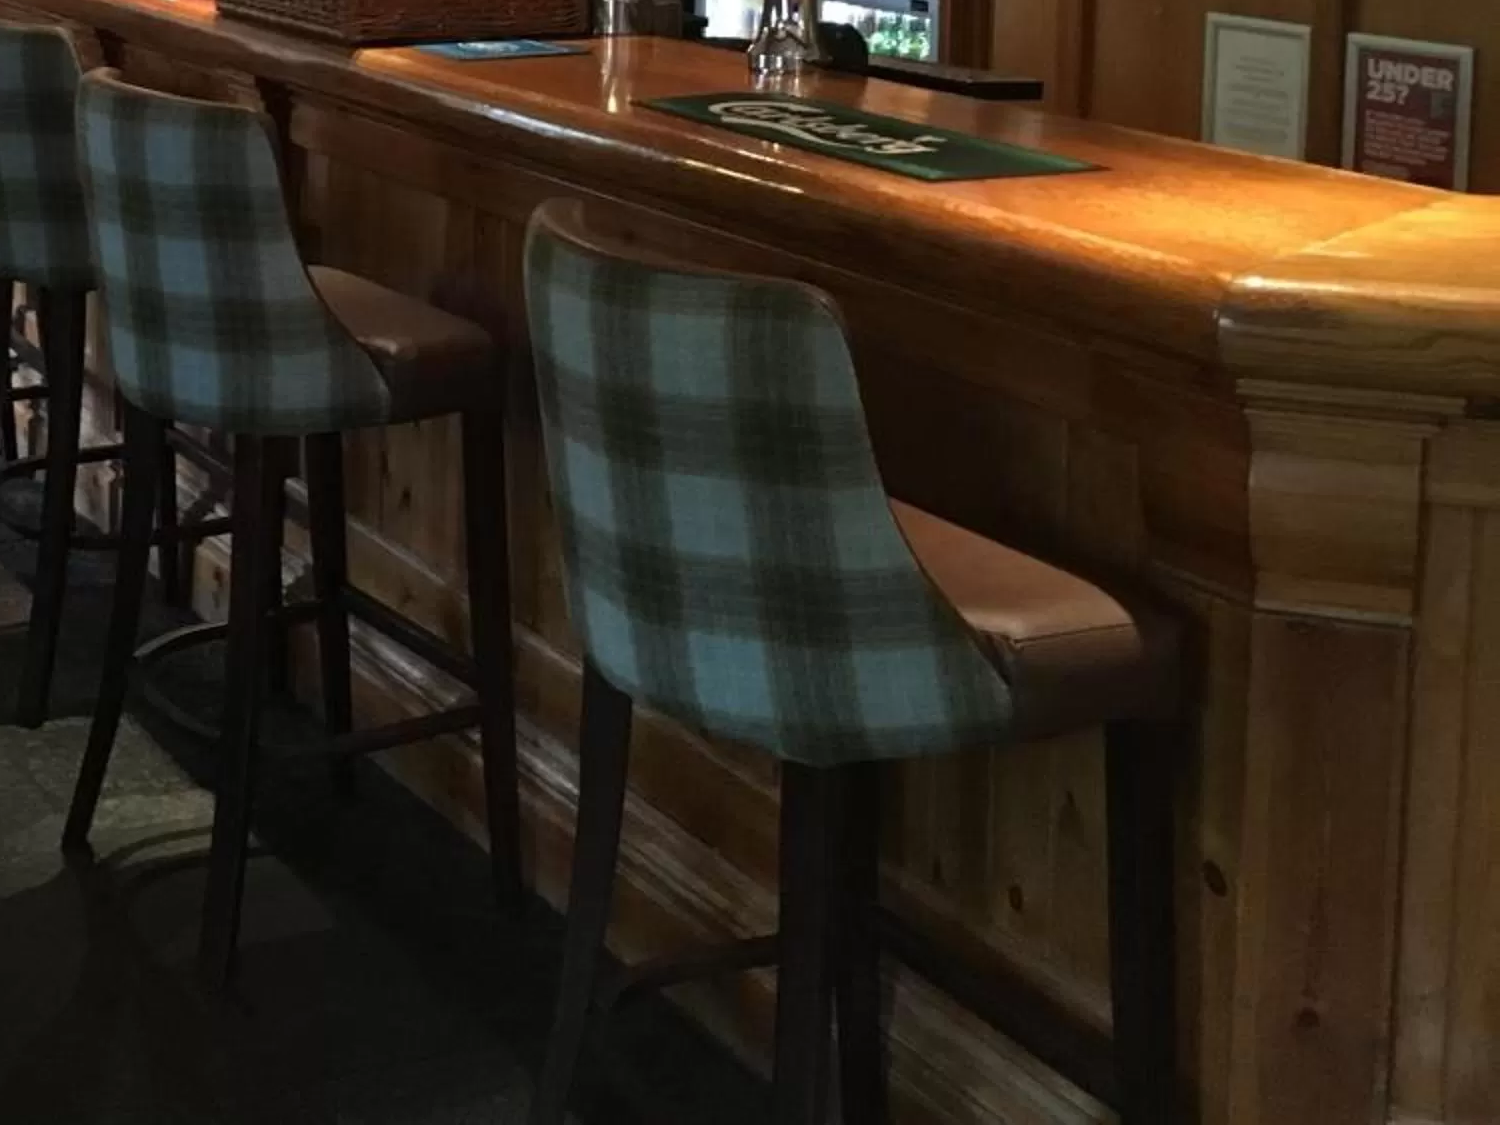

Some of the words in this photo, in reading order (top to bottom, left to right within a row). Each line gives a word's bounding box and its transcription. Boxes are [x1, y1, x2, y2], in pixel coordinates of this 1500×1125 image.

[1367, 58, 1454, 91] UNDER
[1366, 80, 1409, 105] 25?
[708, 101, 948, 154] Carlsberg
